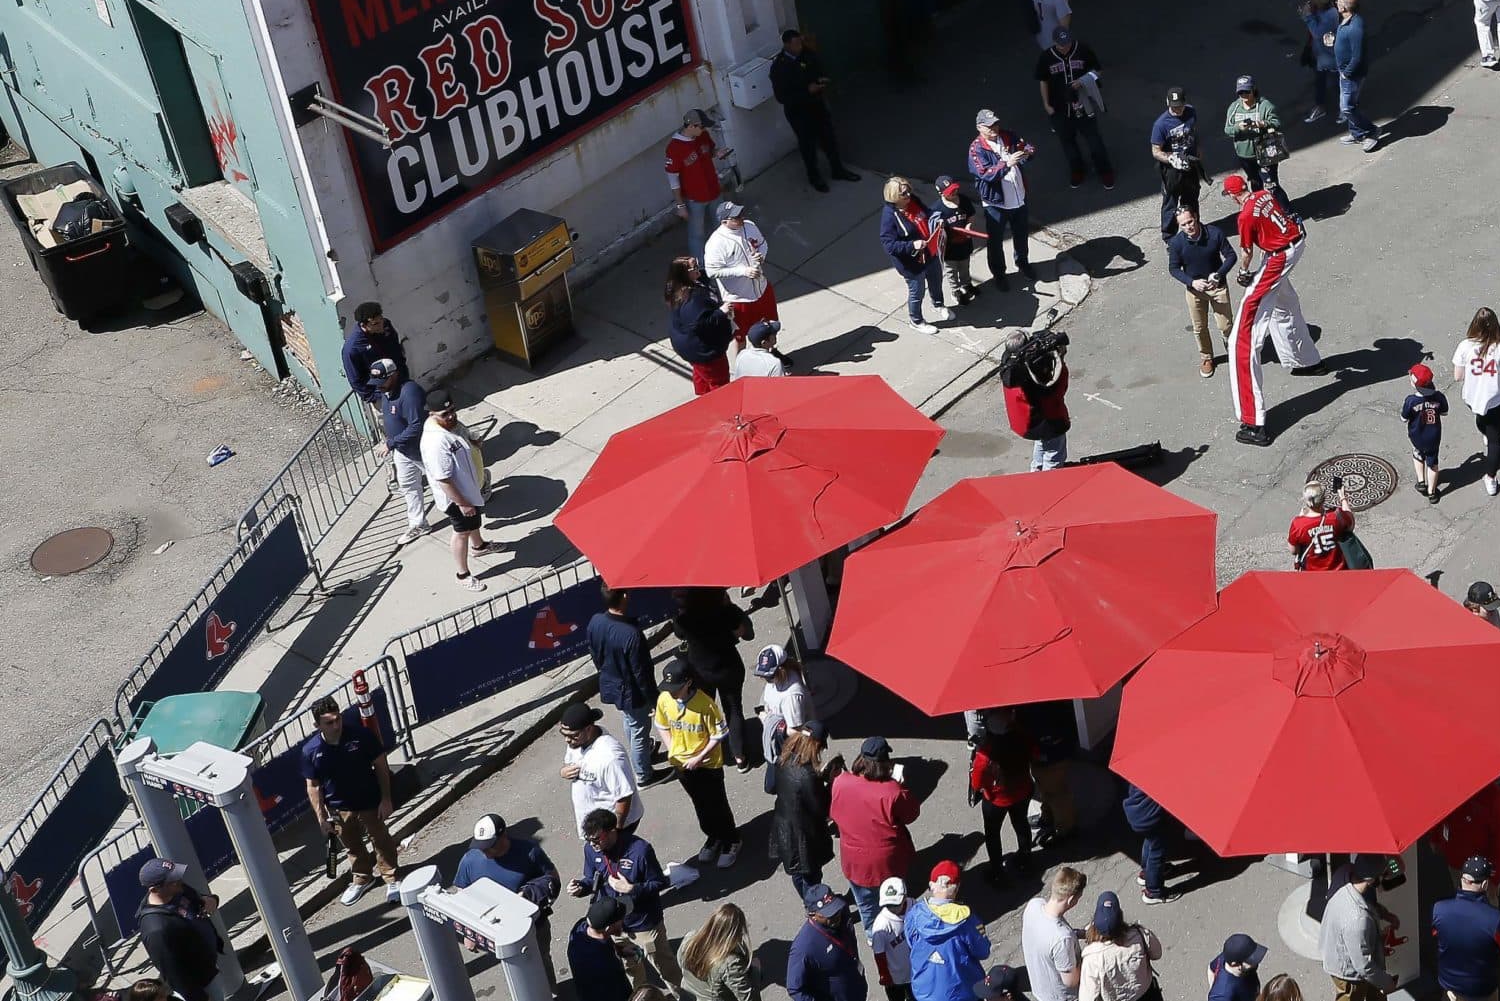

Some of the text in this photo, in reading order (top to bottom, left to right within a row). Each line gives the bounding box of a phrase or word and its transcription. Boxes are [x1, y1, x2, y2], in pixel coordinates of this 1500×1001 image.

[364, 15, 513, 138] RED
[528, 311, 545, 325] ups
[1471, 359, 1497, 377] 34
[1312, 533, 1336, 554] 15
